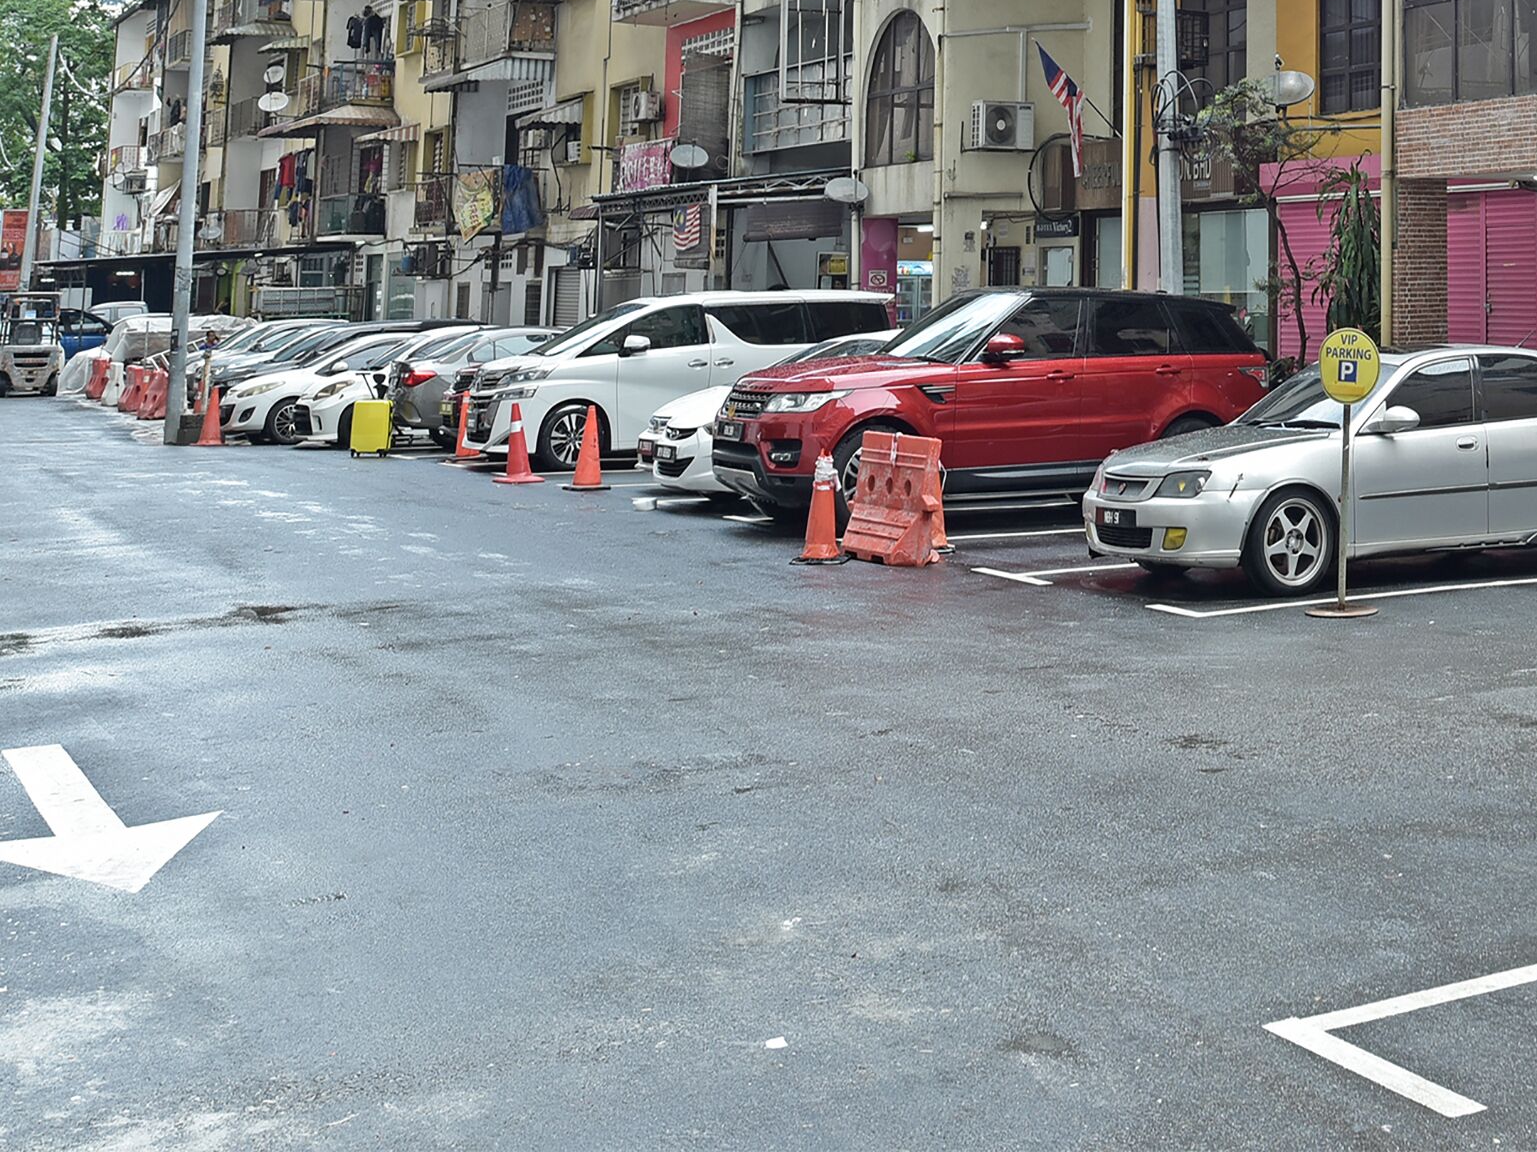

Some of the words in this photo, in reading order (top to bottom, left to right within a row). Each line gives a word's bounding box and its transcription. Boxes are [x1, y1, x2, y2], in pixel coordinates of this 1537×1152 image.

[1340, 334, 1358, 345] VIP
[1326, 347, 1371, 360] PARKING
[1341, 362, 1354, 380] P
